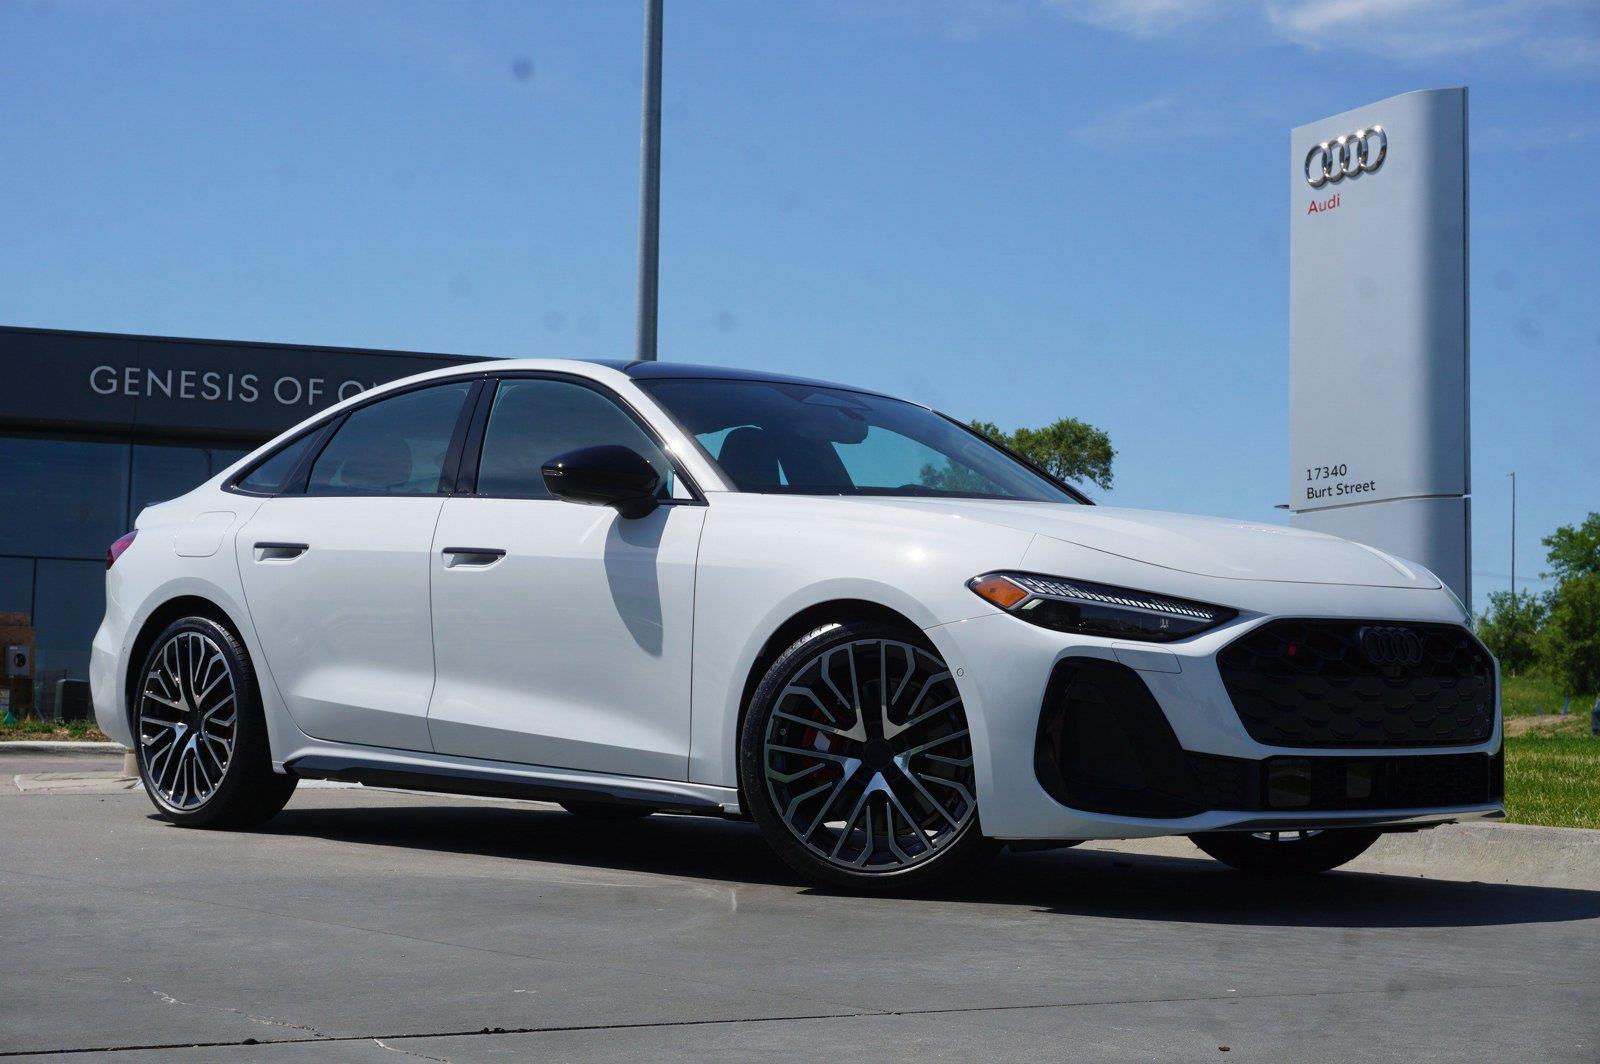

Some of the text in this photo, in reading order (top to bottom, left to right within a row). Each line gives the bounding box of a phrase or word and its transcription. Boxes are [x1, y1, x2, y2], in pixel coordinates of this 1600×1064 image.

[1308, 194, 1340, 215] Audi
[89, 365, 259, 403] GENESIS
[273, 376, 324, 406] OF
[1306, 464, 1347, 481] 17340
[1307, 480, 1376, 499] Burt Street
